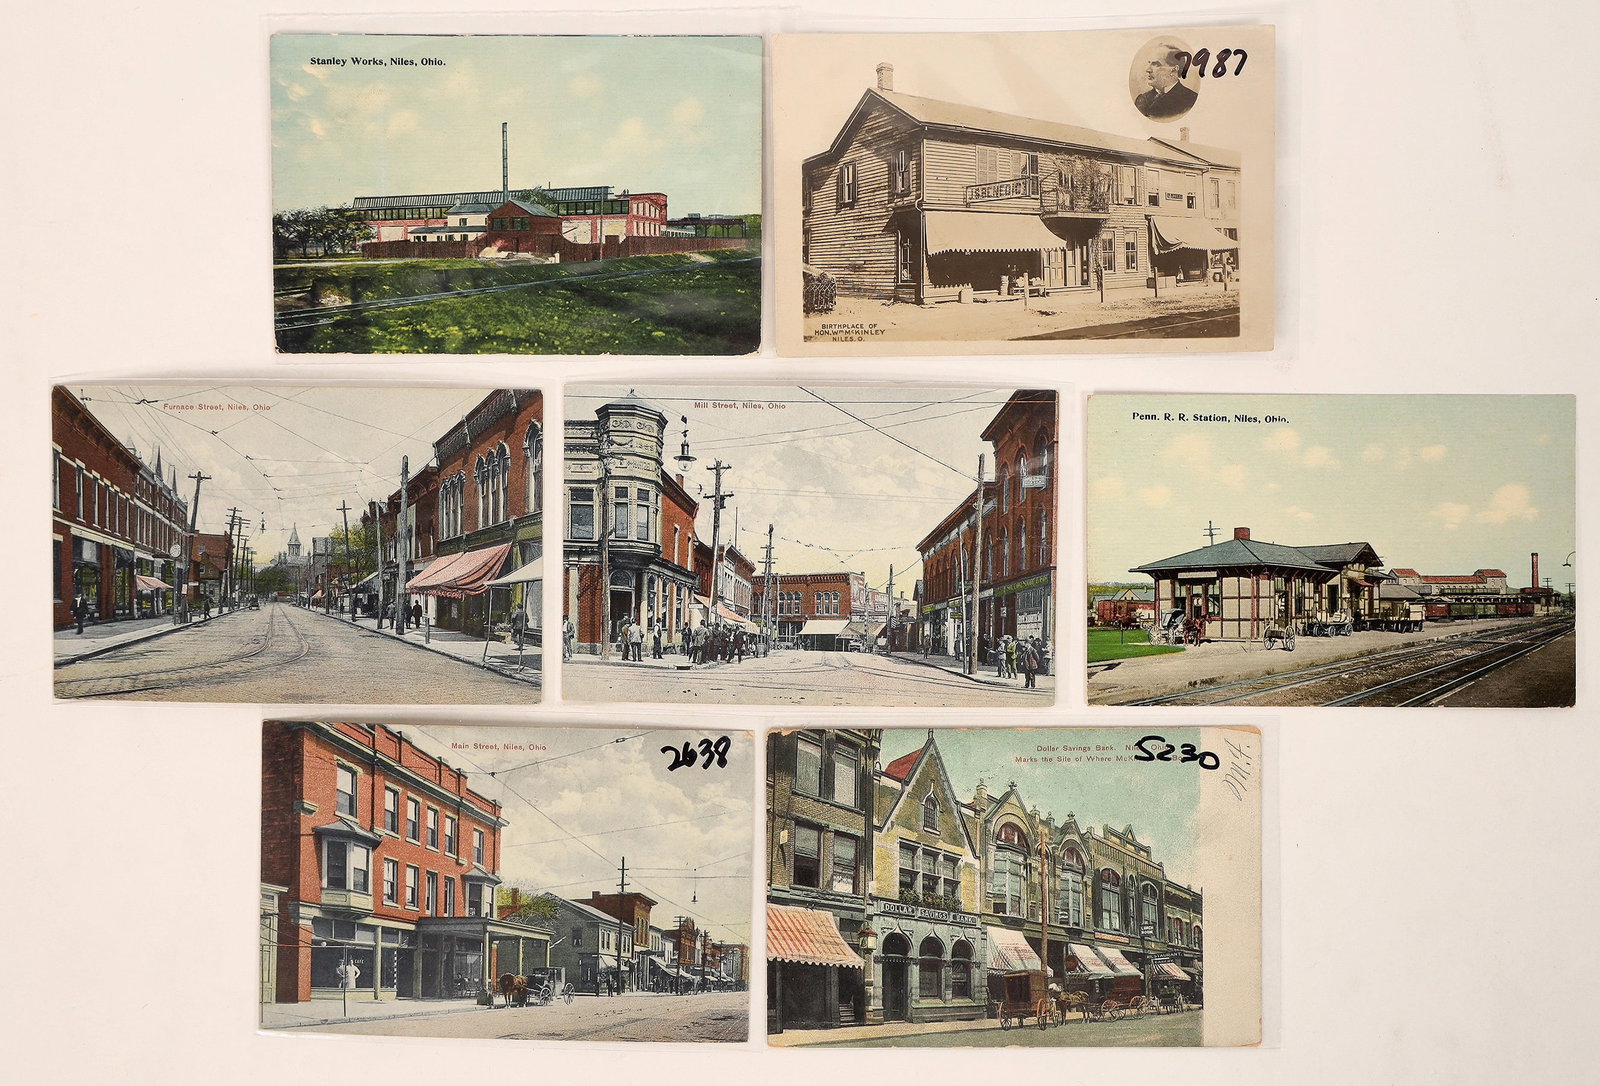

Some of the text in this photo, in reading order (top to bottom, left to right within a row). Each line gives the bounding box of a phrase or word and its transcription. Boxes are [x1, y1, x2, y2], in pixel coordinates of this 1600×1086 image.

[310, 57, 347, 67] Stanley
[351, 57, 387, 66] Works,
[390, 58, 418, 66] Niles,
[1174, 48, 1248, 79] 7987
[1132, 412, 1289, 424] Penn. R. R. Station, Niles, Ohio.
[473, 742, 500, 750] Street,
[503, 743, 524, 751] Niles,
[660, 736, 731, 772] 2638
[886, 903, 914, 914] DOLLAR
[921, 909, 947, 920] SAVINGS
